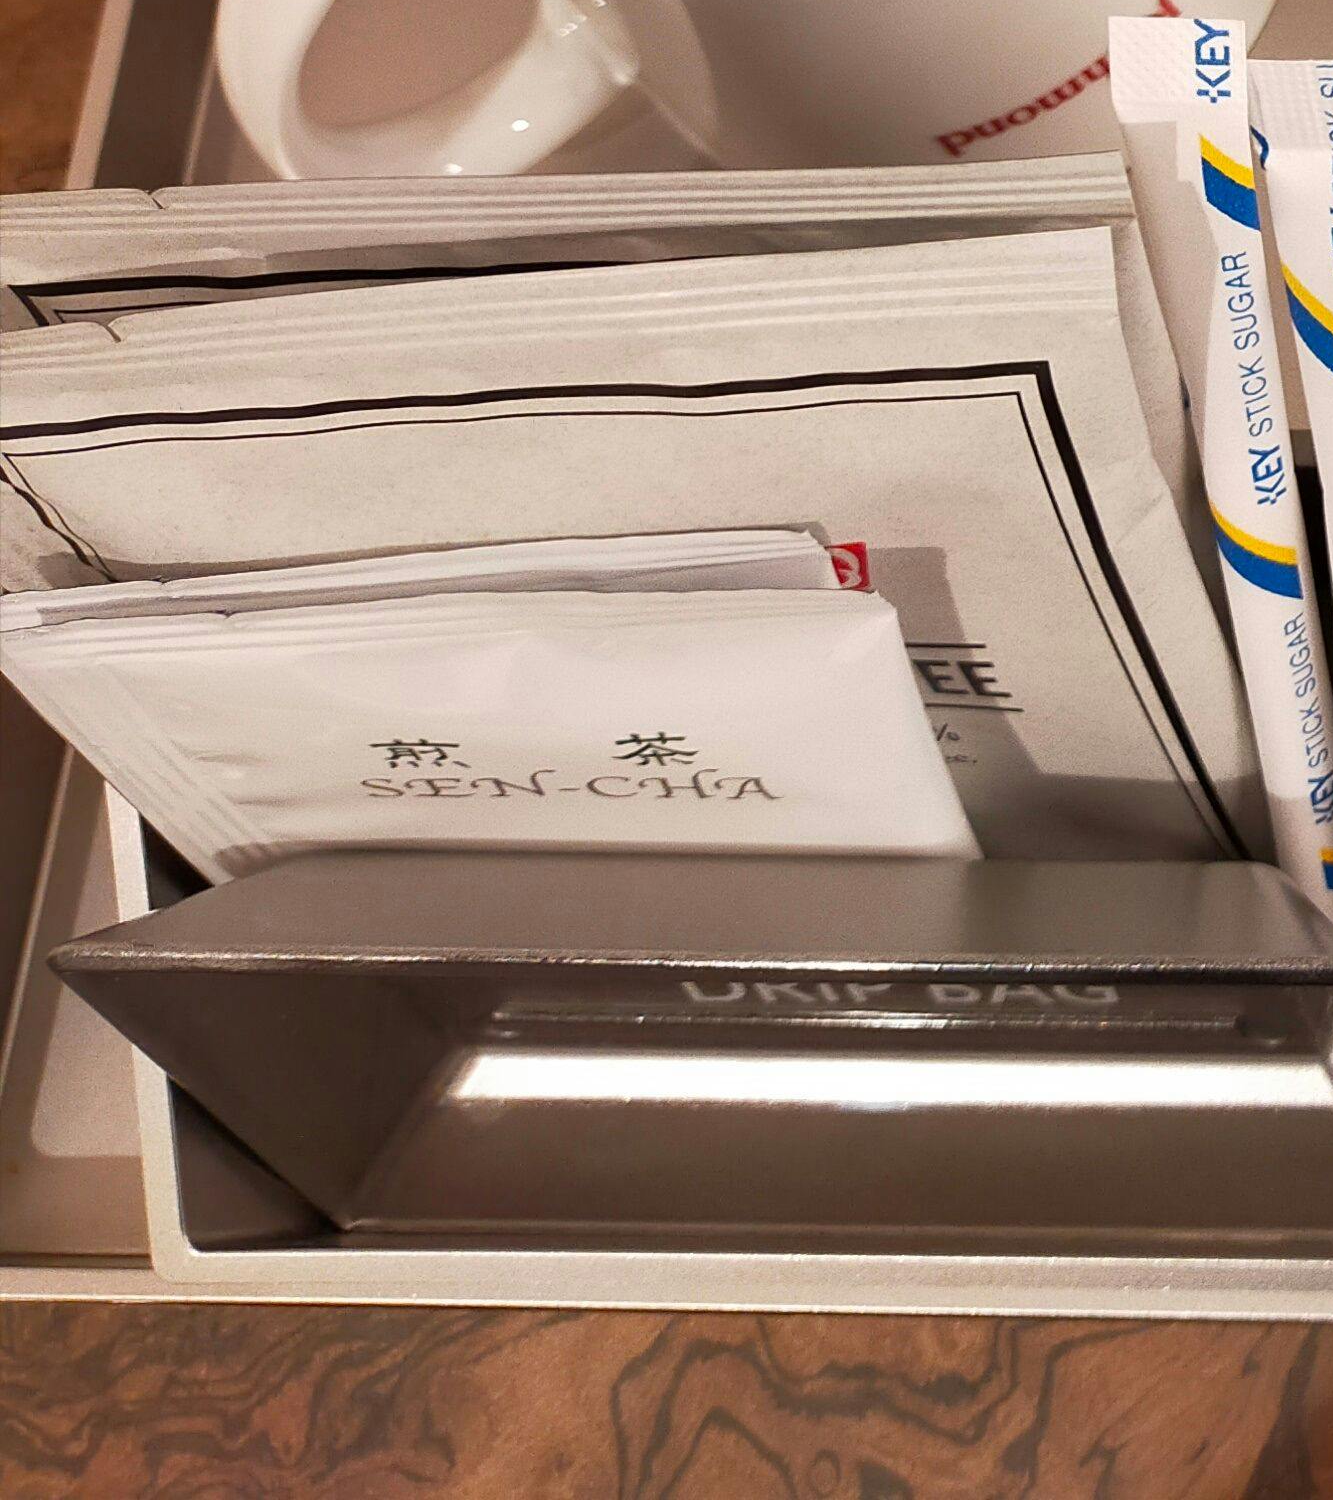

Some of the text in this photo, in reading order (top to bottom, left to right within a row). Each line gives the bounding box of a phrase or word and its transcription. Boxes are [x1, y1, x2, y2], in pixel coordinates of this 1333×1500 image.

[1193, 18, 1232, 103] KEY
[1221, 250, 1287, 506] KEY STICK SUGAR
[1283, 613, 1318, 701] SUGAR
[1298, 698, 1331, 770] STICK
[361, 769, 784, 801] SEN-CHA
